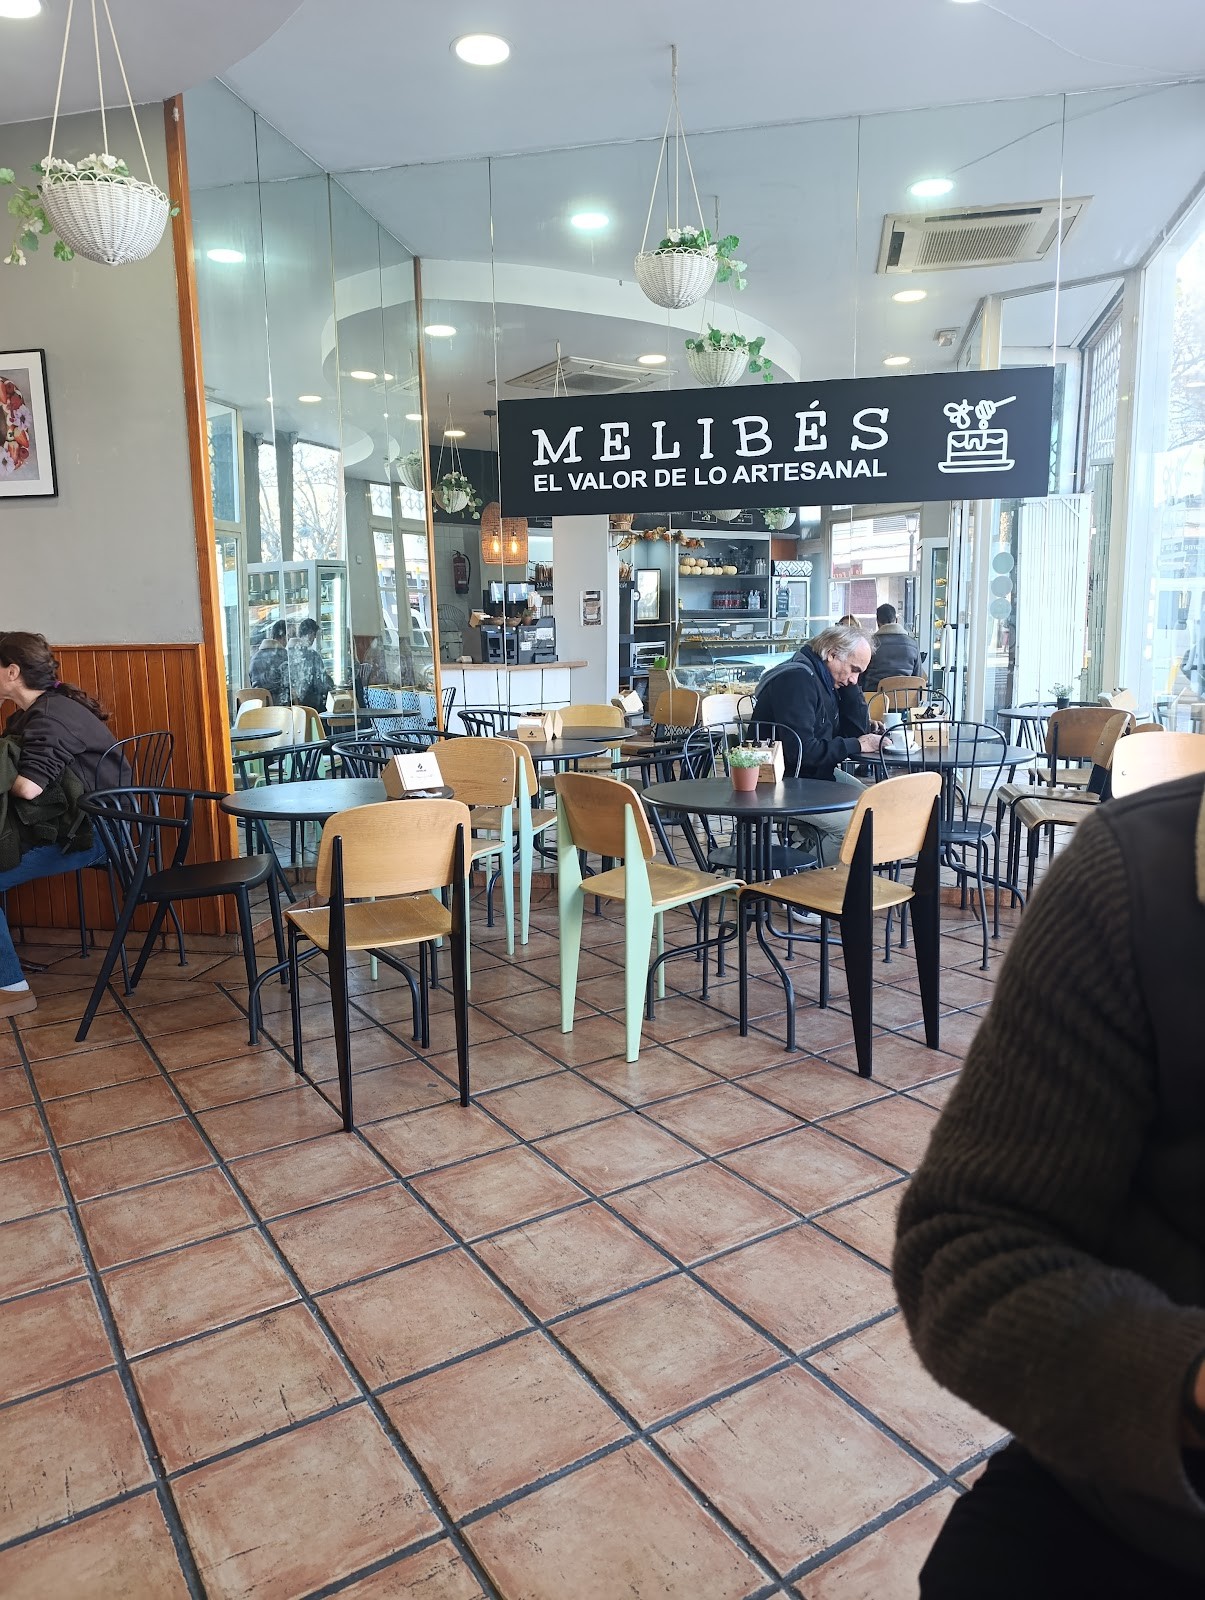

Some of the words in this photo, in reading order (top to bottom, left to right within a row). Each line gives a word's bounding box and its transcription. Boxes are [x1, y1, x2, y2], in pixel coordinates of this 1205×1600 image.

[532, 400, 889, 466] MELIBÉS
[534, 474, 562, 492] EL
[568, 470, 648, 490] VALOR
[654, 468, 687, 488] DE
[694, 466, 727, 485] LO
[732, 459, 887, 484] ARTESANAL
